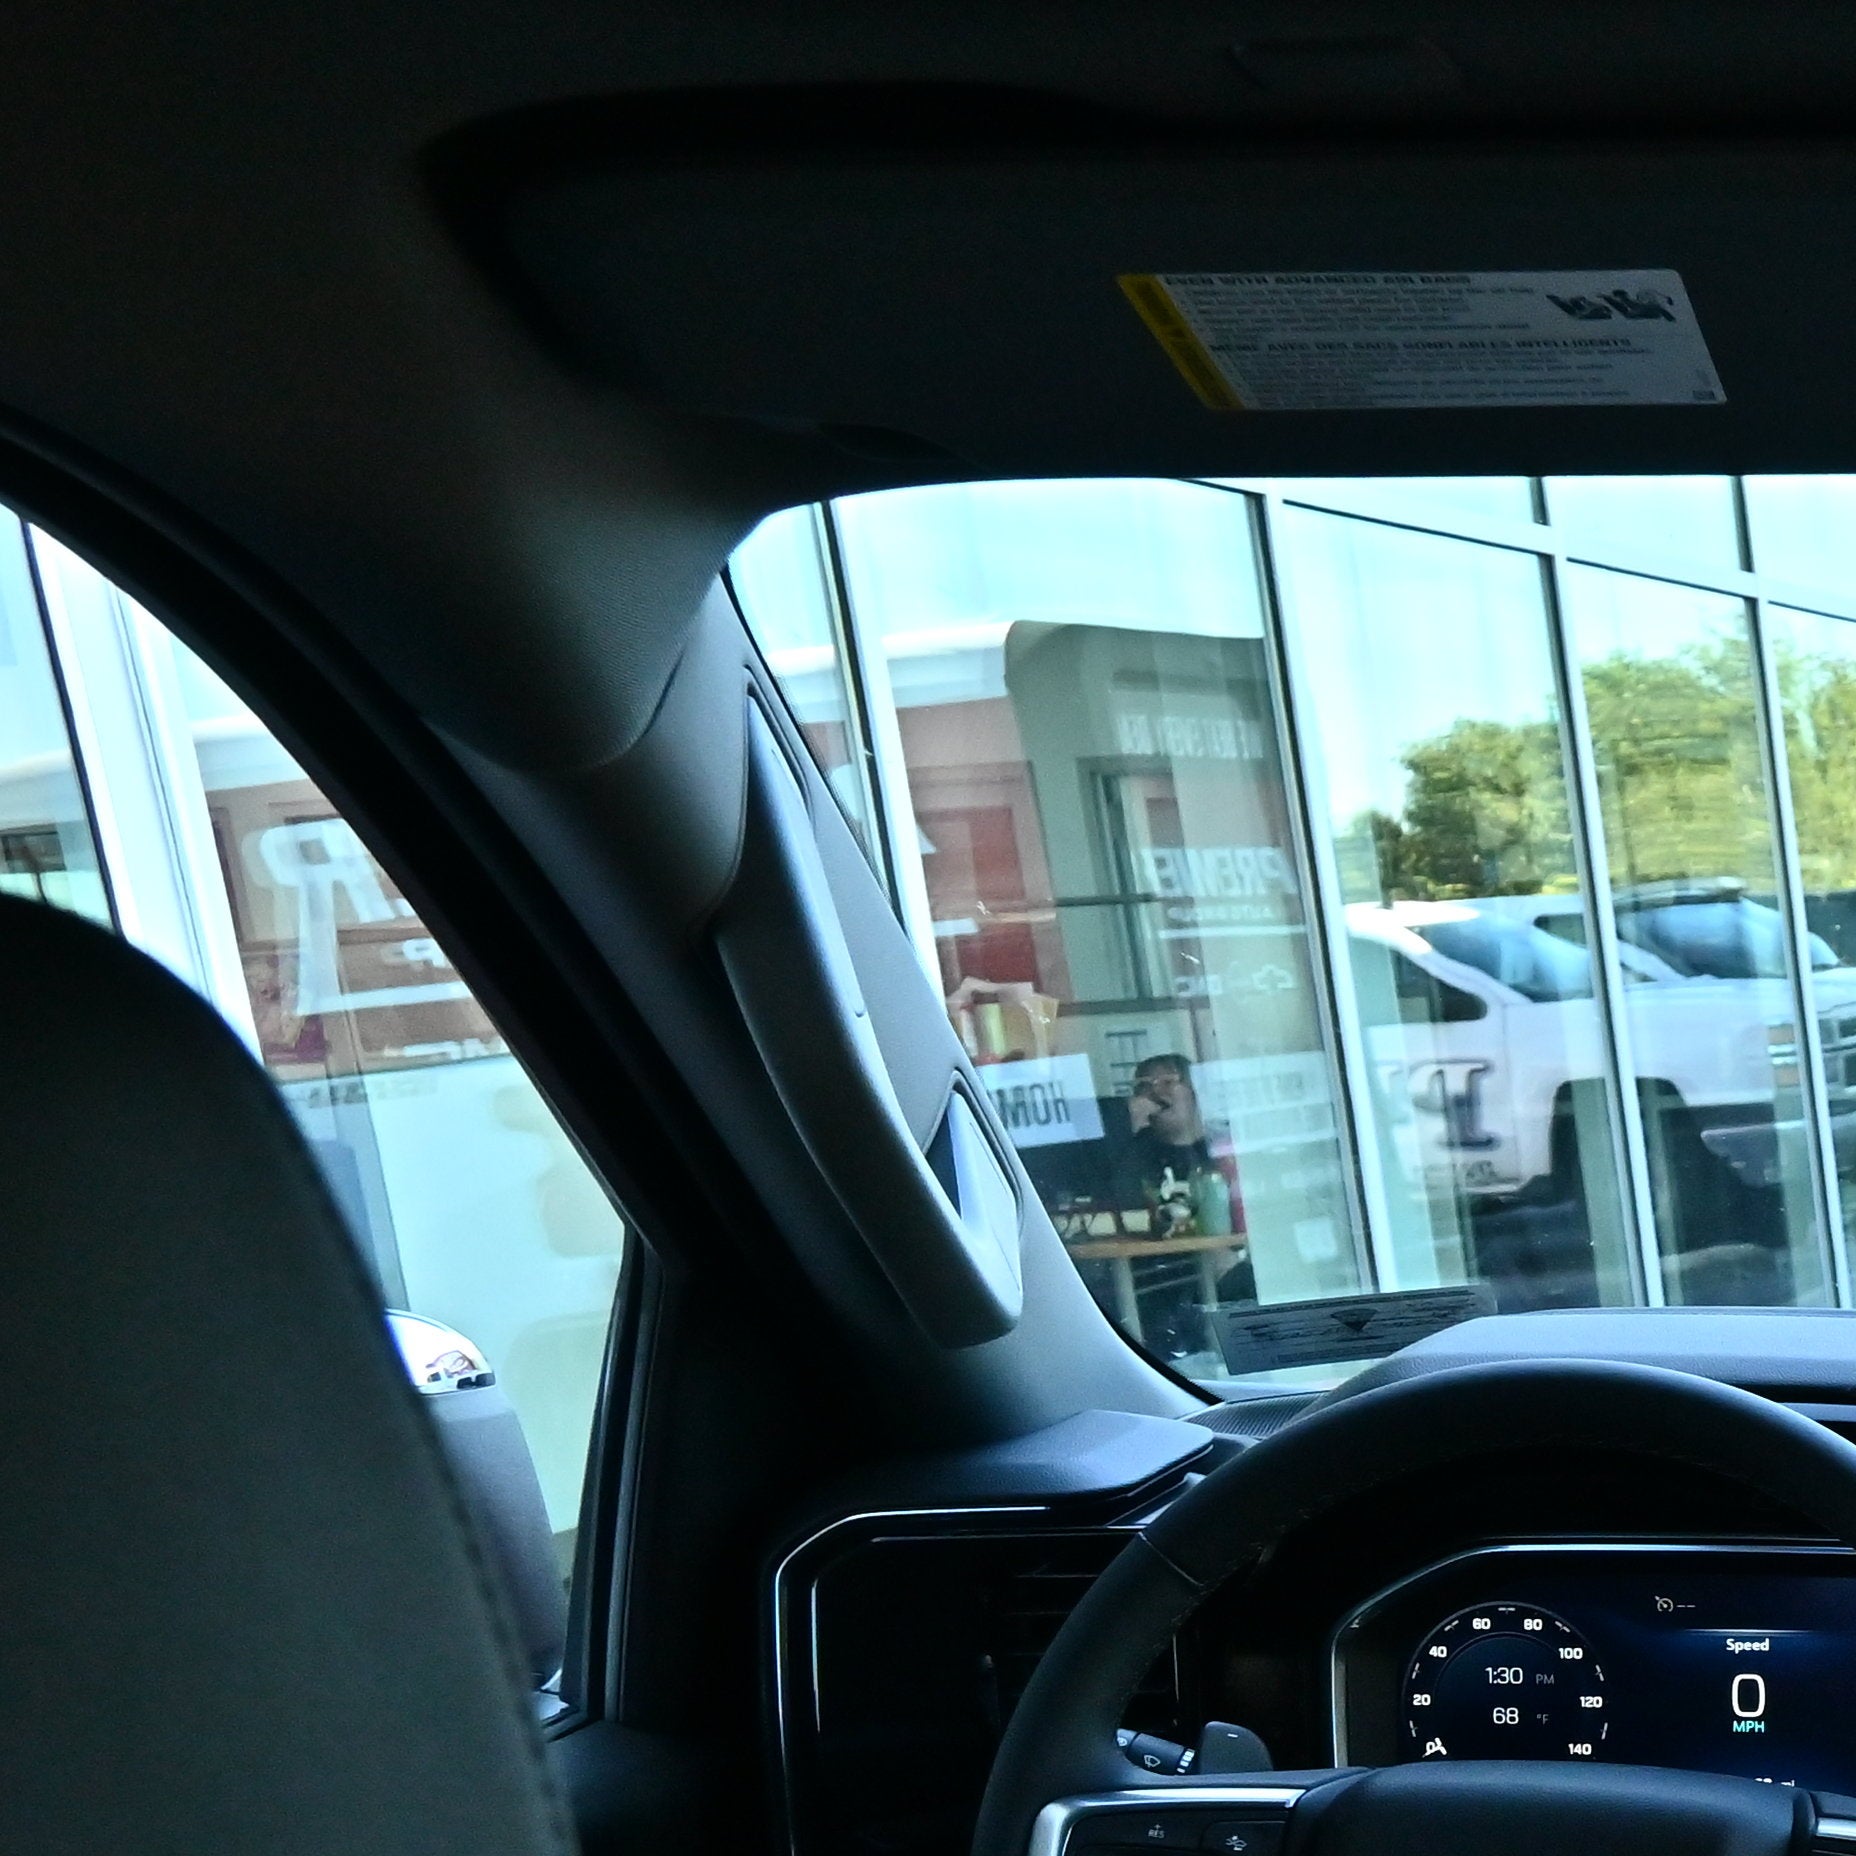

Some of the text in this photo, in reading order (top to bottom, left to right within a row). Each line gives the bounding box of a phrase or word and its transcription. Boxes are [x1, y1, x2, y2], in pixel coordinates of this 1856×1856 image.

[1472, 1618, 1491, 1630] 60
[1522, 1618, 1543, 1631] 80
[1428, 1646, 1448, 1658] 40
[1726, 1638, 1770, 1654] Speed
[1558, 1647, 1583, 1660] 100
[1485, 1667, 1555, 1685] 1:30 PM
[1412, 1694, 1431, 1706] 20
[1579, 1696, 1603, 1708] 120
[1731, 1673, 1766, 1718] 0
[1492, 1707, 1519, 1724] 68
[1732, 1720, 1765, 1733] MPH
[1567, 1743, 1592, 1756] 140
[1148, 1828, 1165, 1838] RES
